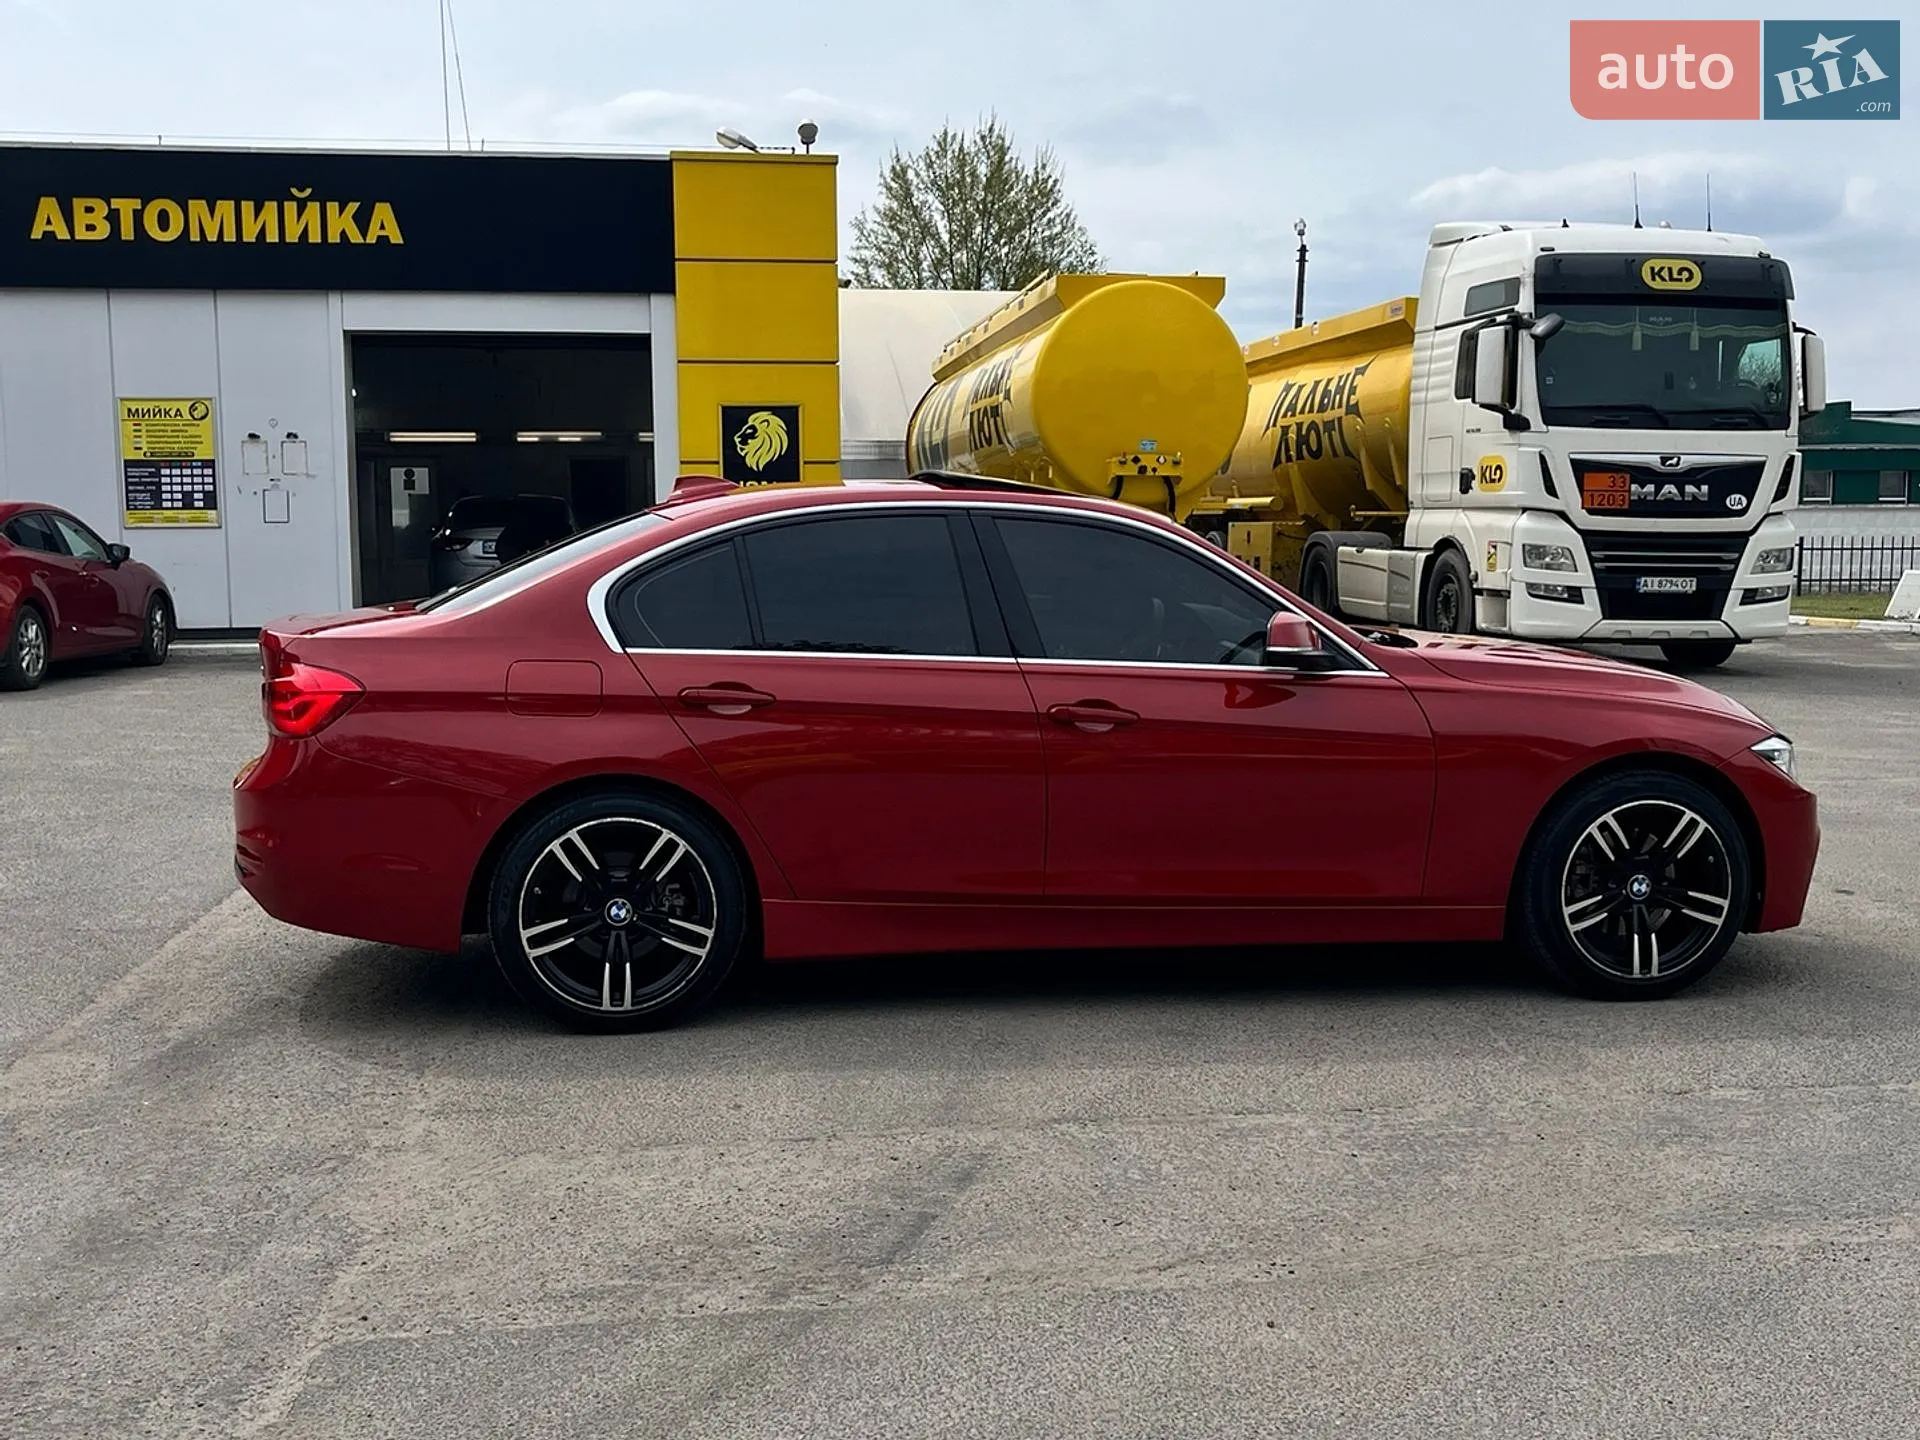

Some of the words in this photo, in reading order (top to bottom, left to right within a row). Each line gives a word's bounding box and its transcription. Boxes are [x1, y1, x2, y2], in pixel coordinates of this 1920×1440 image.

[30, 187, 404, 244] АВТОМИЙКА
[1649, 265, 1695, 283] KLO
[1261, 353, 1381, 440] ПАЛЬНЕ
[126, 405, 184, 418] МИЙКА
[1272, 416, 1361, 469] ЛЮТІ
[1480, 464, 1503, 484] KLO
[1608, 475, 1627, 488] 33
[1588, 493, 1627, 507] 1203
[1630, 483, 1709, 501] MAN
[1729, 496, 1744, 508] UA
